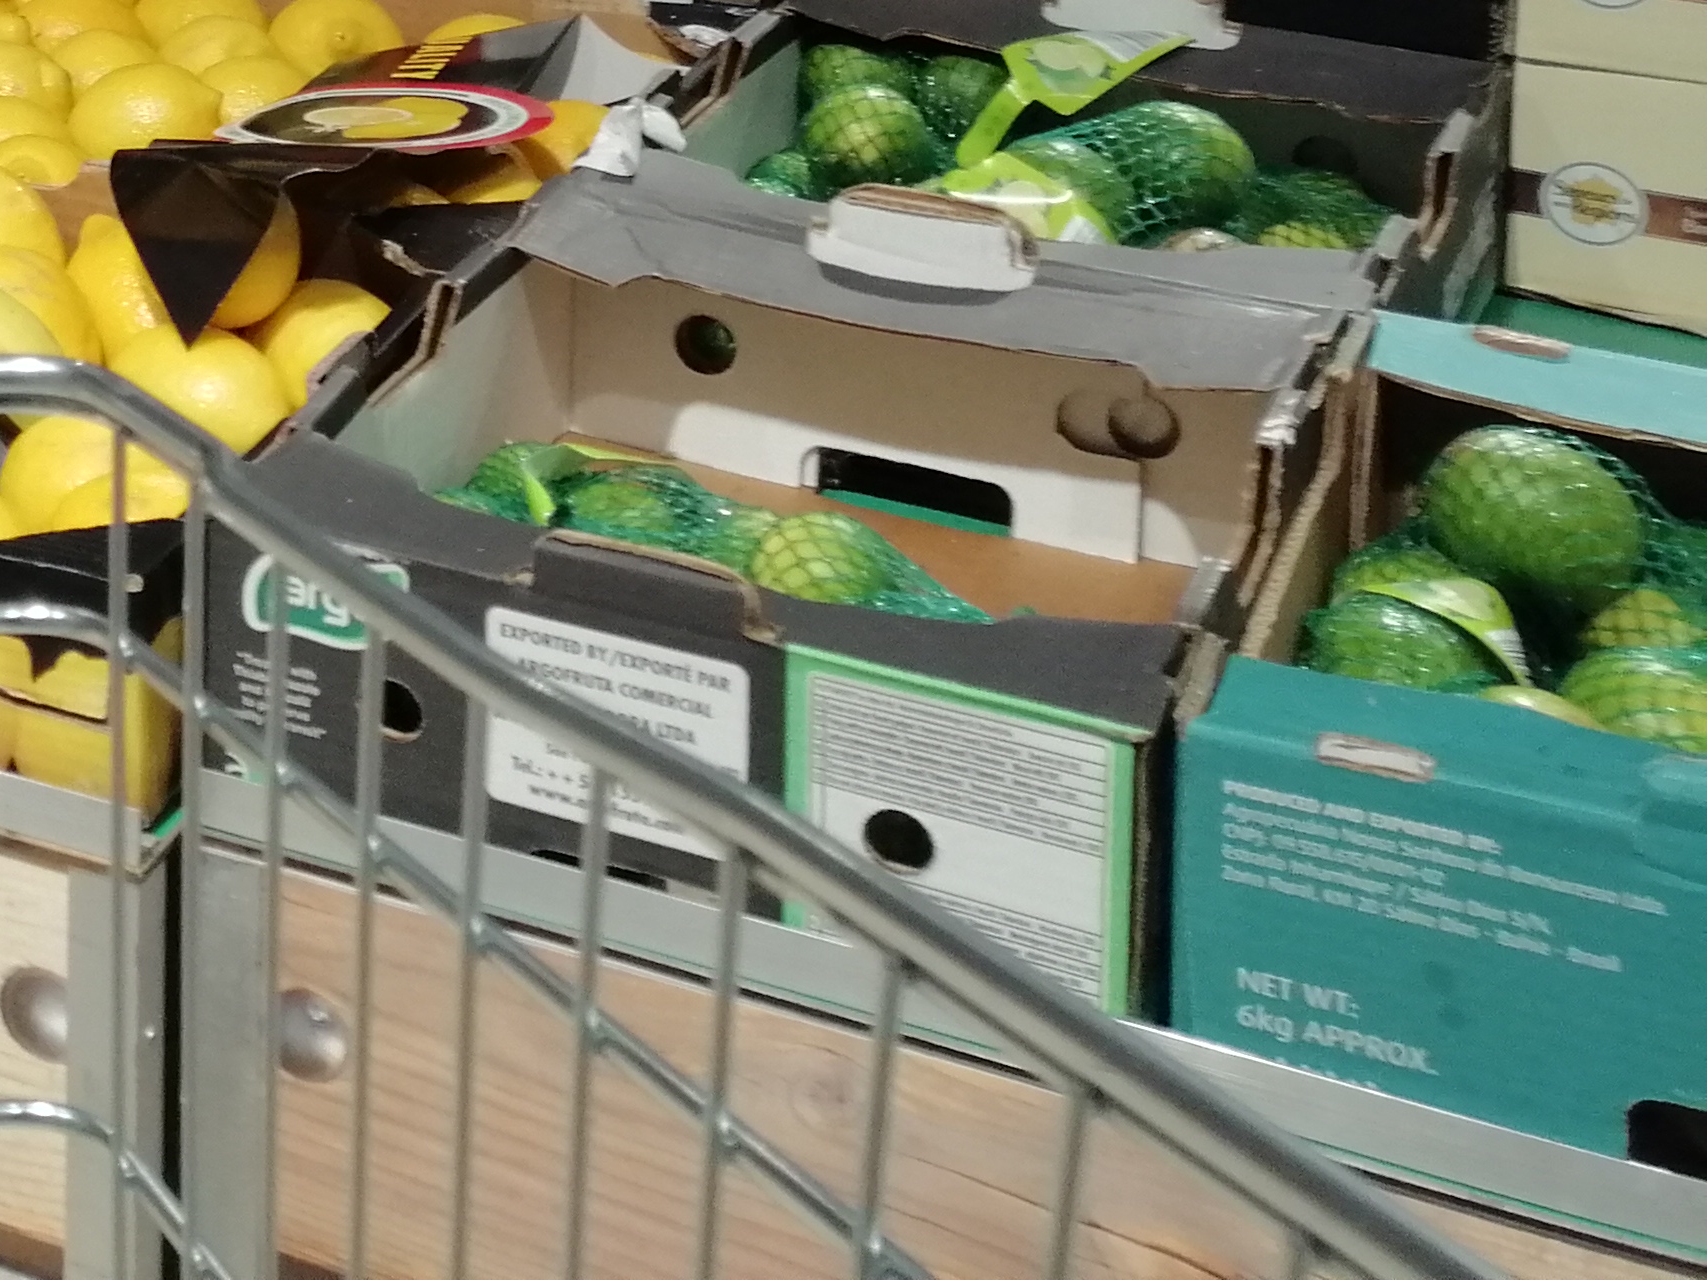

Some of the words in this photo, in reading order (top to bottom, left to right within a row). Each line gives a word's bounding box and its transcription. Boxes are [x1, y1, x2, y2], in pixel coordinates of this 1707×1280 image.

[500, 622, 584, 655] EXPORTED
[697, 670, 730, 690] PAR
[619, 682, 715, 720] COMERCIAL
[1236, 966, 1294, 1002] NET
[1301, 979, 1362, 1019] WT:
[1235, 1003, 1295, 1044] 6kg
[1300, 1018, 1440, 1077] APPROX.
